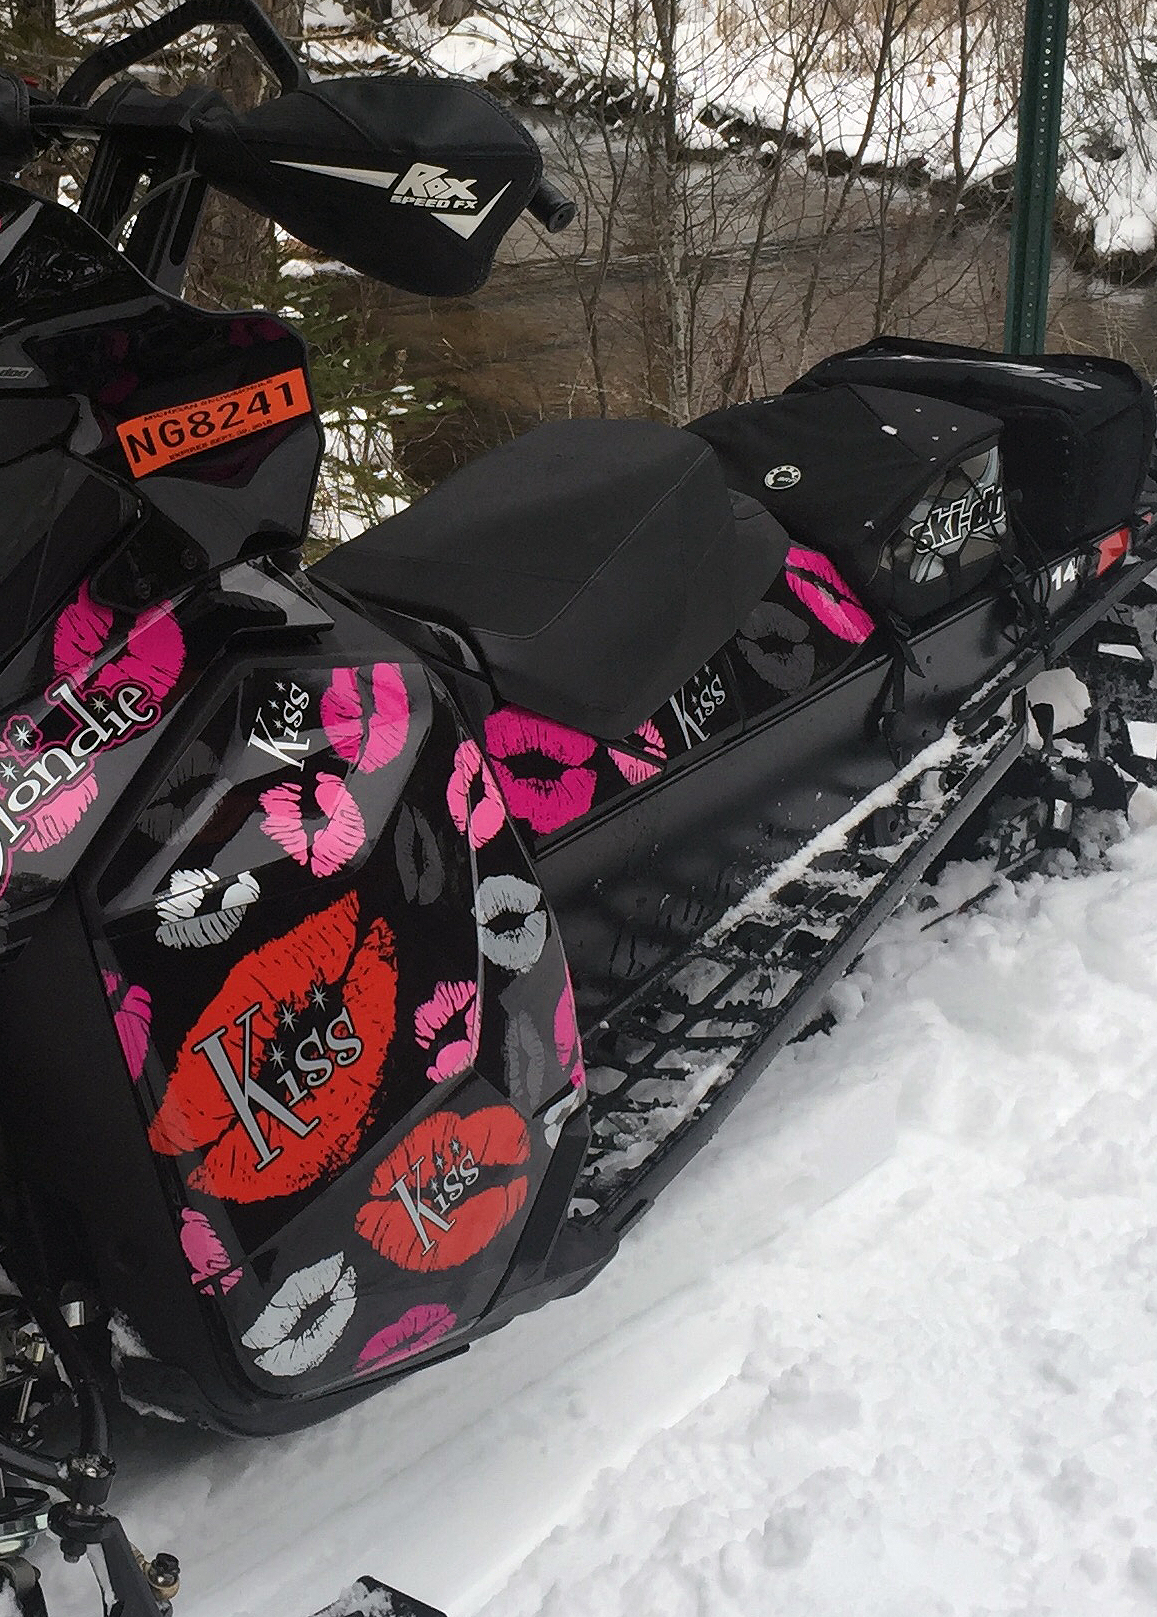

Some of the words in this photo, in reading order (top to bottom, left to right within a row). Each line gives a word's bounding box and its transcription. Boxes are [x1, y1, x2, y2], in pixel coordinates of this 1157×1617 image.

[390, 195, 451, 209] SPEED
[452, 200, 478, 209] FX
[125, 381, 295, 465] NG8241
[247, 681, 313, 772] Kiss
[669, 673, 726, 750] Kiss
[193, 1003, 363, 1171] Kiss
[390, 1149, 480, 1257] Kiss
